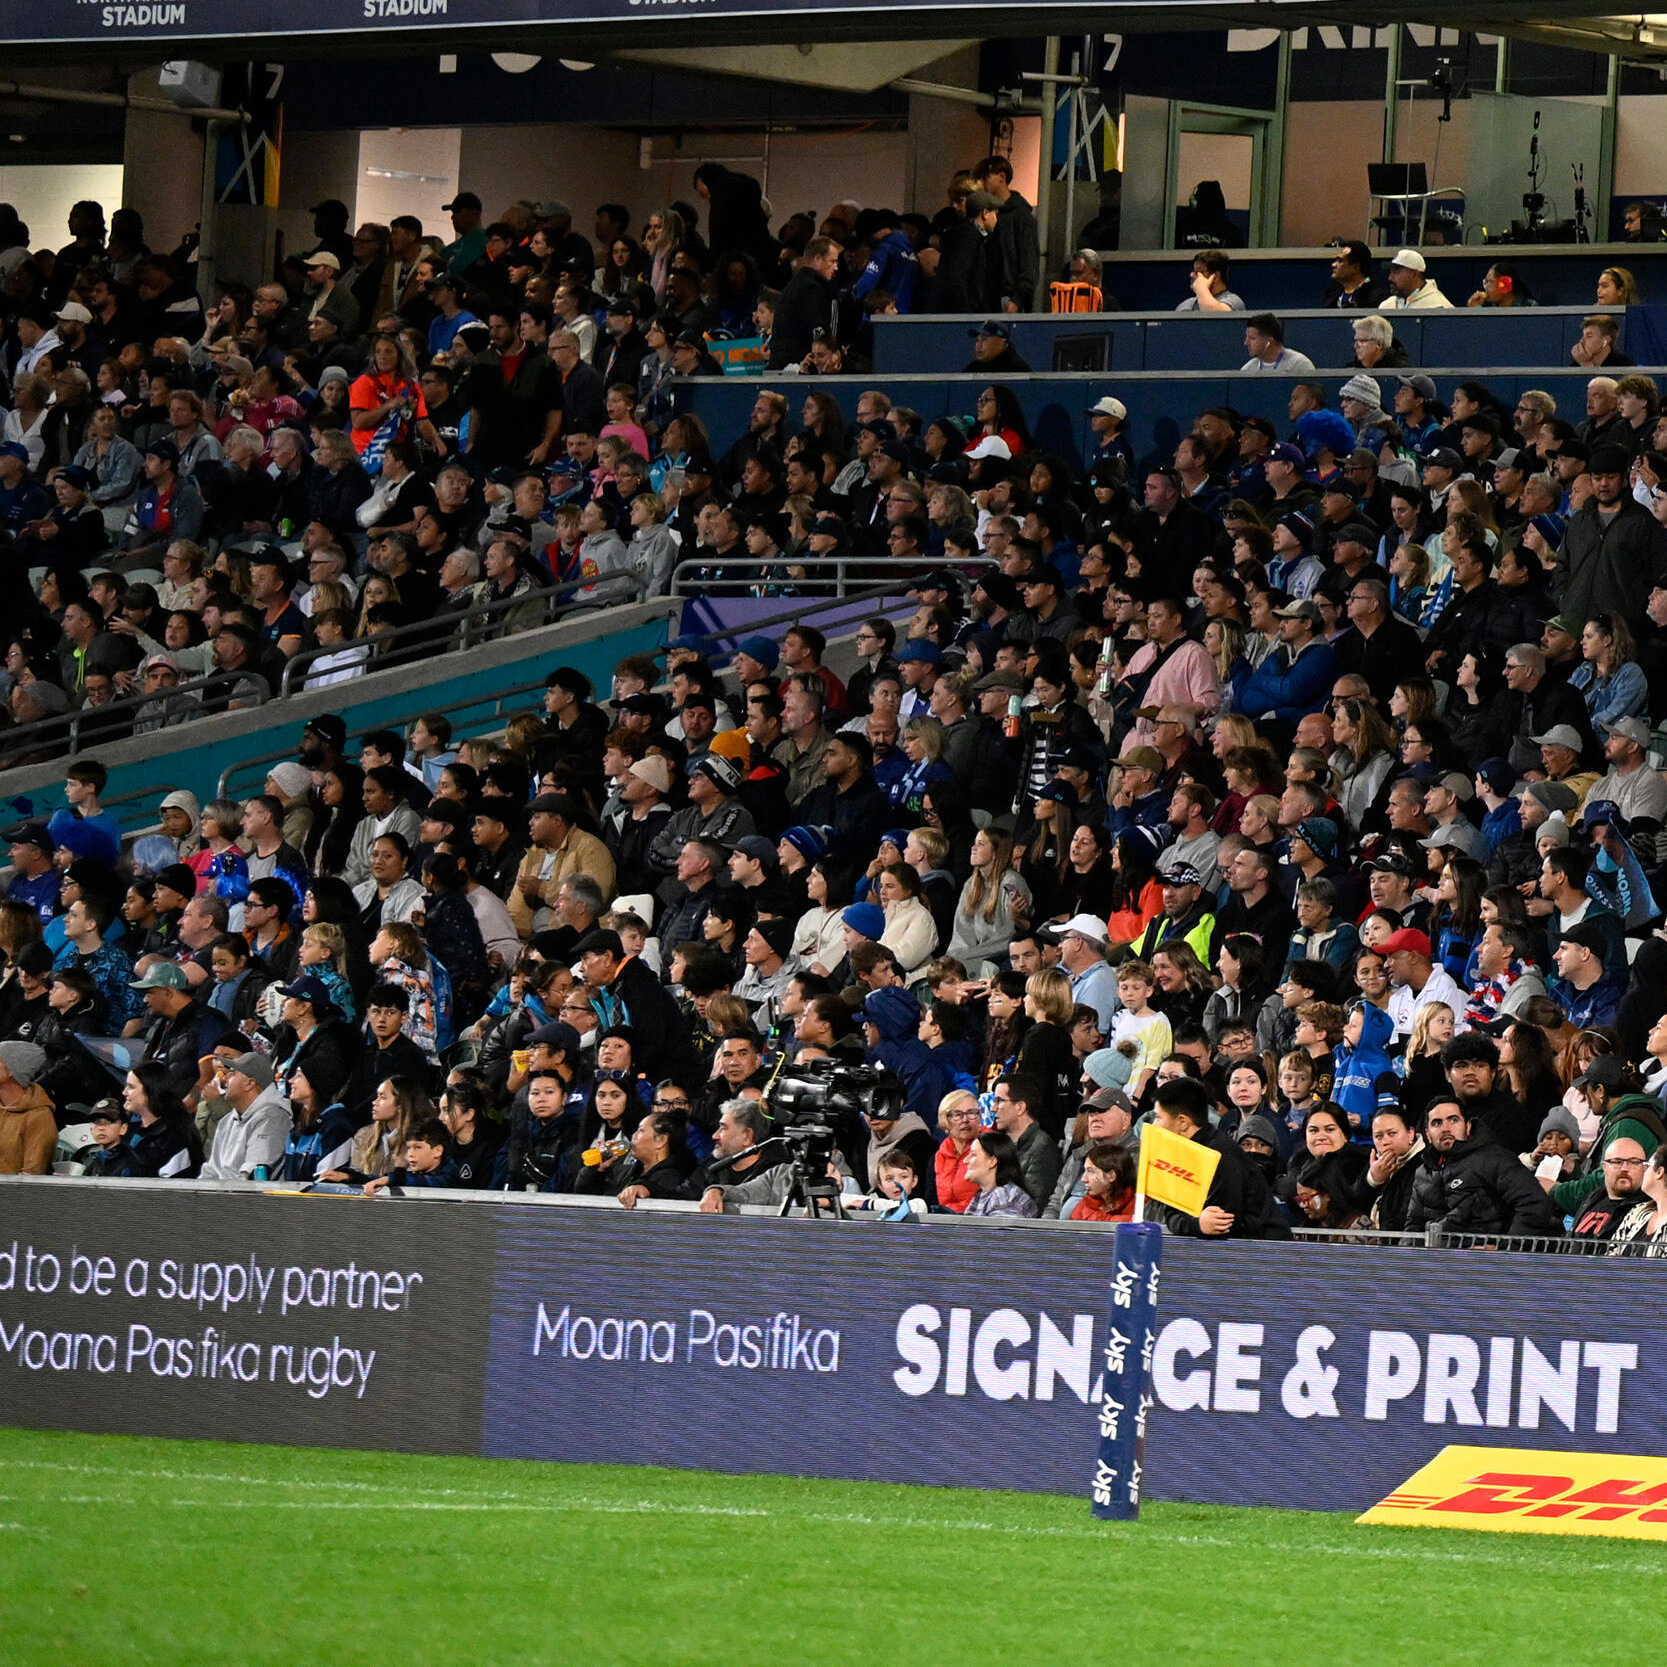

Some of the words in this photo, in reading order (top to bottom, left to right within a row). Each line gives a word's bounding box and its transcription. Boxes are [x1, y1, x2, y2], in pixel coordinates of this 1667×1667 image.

[102, 4, 185, 26] STADIUM
[1103, 33, 1123, 71] 7
[1150, 1158, 1200, 1185] DHL
[25, 1246, 60, 1292] to
[69, 1245, 116, 1296] be
[125, 1259, 148, 1296] a
[157, 1254, 275, 1314] supply
[282, 1262, 423, 1315] partner
[1110, 1262, 1138, 1308] sky
[1147, 1262, 1160, 1306] sky
[534, 1303, 675, 1362] Moana
[687, 1310, 841, 1373] Pasifika
[1104, 1327, 1131, 1374] sky
[1141, 1328, 1155, 1372] sky
[127, 1325, 260, 1381] Pasifika
[270, 1336, 376, 1398] rugby
[893, 1304, 1263, 1413] SIGNGE
[1281, 1325, 1340, 1418] &
[1365, 1331, 1638, 1433] PRINT
[1098, 1393, 1124, 1440] sky
[1134, 1394, 1147, 1438] sky
[1091, 1459, 1117, 1505] sky
[1128, 1460, 1142, 1504] sky
